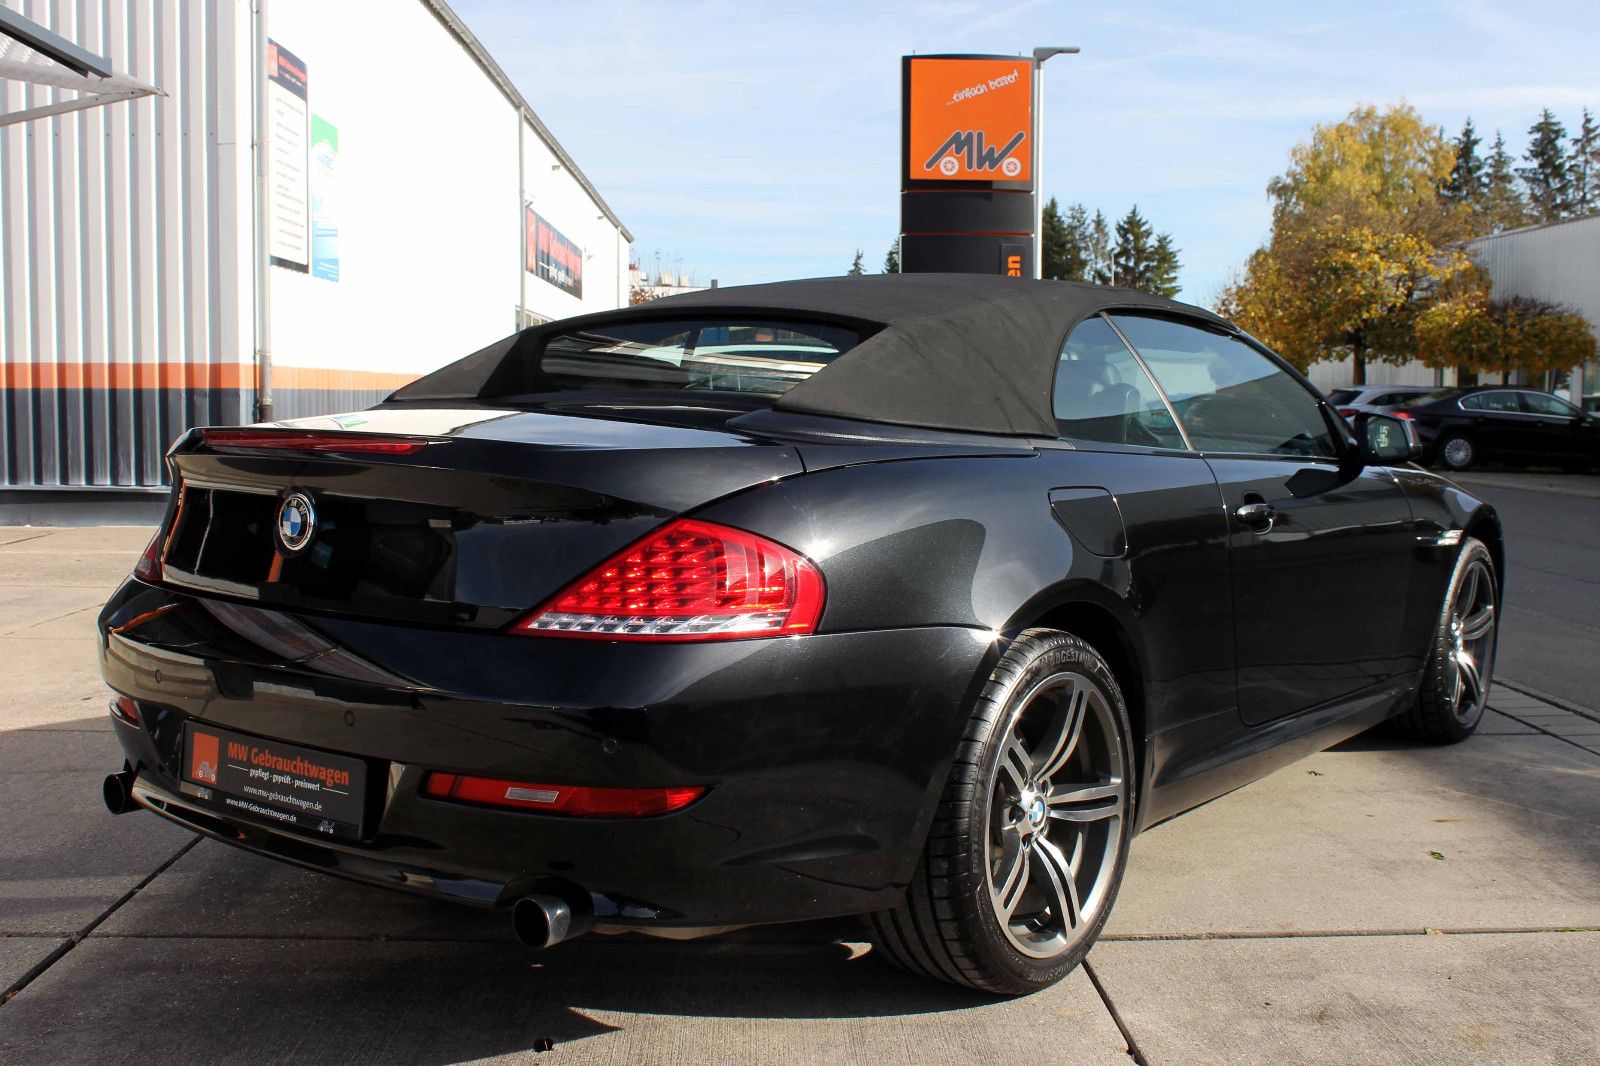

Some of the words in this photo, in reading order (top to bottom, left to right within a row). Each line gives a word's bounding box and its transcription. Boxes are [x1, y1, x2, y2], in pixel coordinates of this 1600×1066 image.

[924, 130, 1026, 171] MW
[228, 742, 248, 762] MW
[251, 747, 349, 787] Gebrauchtwagen
[249, 767, 270, 780] gepflegt
[272, 772, 291, 785] geprüft
[294, 777, 320, 791] preiswert
[226, 797, 297, 823] www.MW-Gebrauchtwagen.de
[243, 784, 323, 811] www.mw-gebrauchtwagen.de
